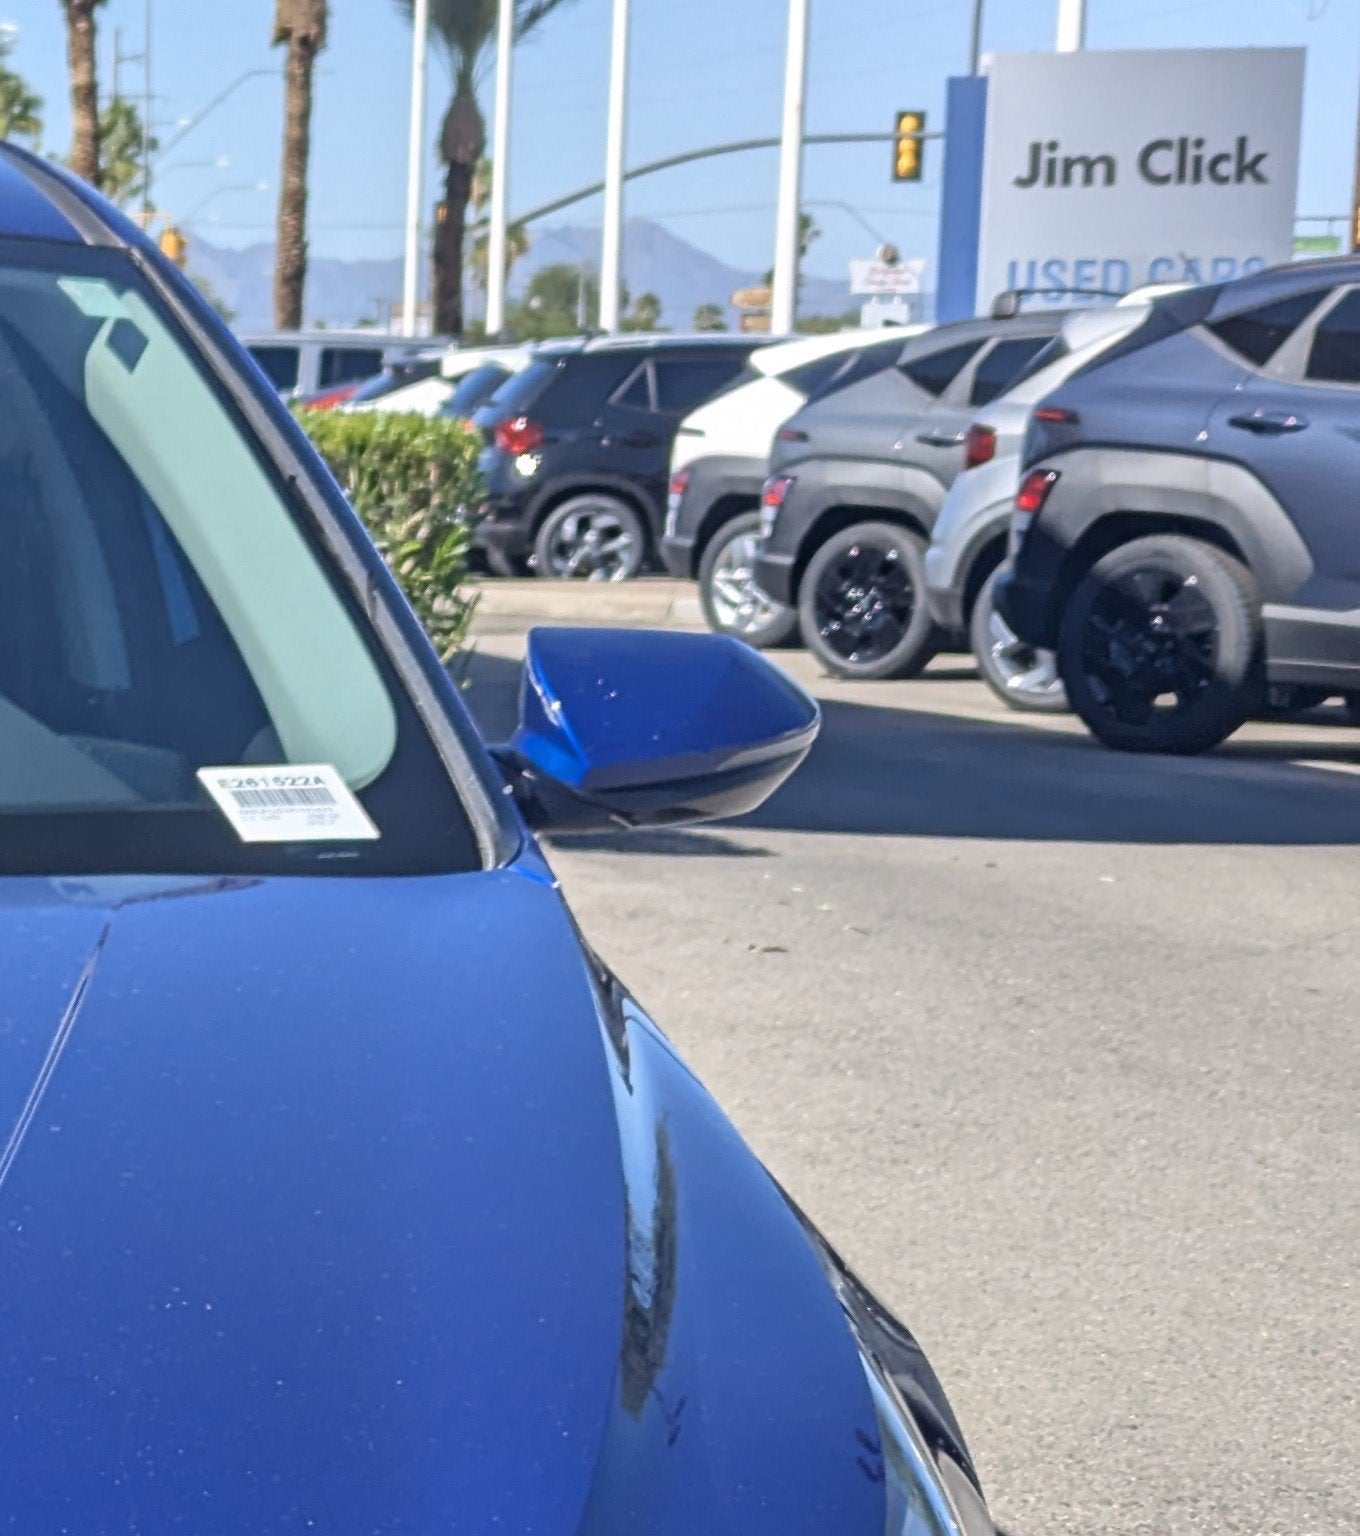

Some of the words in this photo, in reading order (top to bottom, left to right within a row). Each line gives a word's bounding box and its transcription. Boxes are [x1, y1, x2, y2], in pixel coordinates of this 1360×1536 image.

[1012, 139, 1117, 188] Jim
[1137, 135, 1269, 186] Click
[1007, 258, 1129, 304] USED
